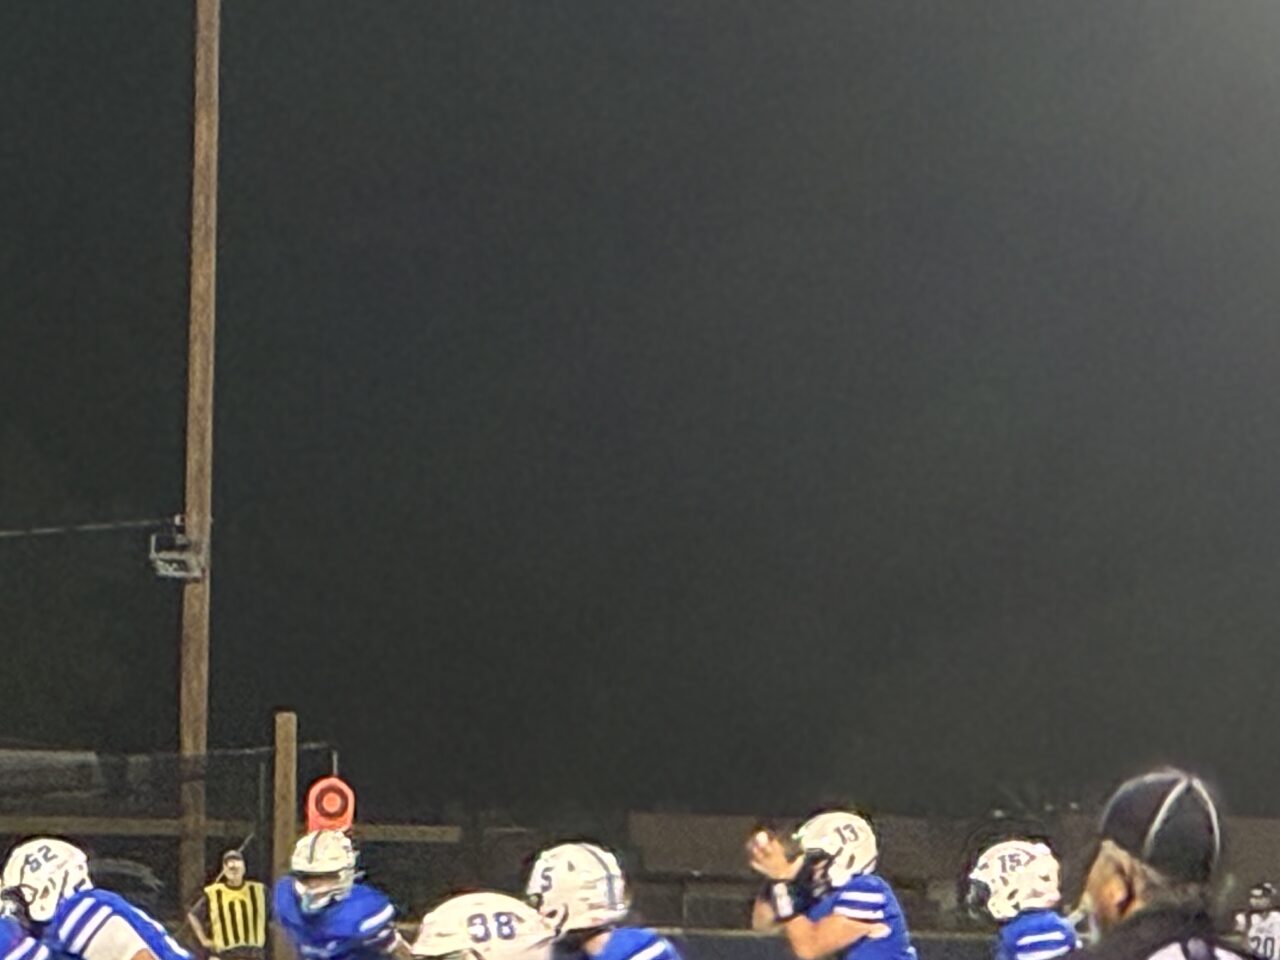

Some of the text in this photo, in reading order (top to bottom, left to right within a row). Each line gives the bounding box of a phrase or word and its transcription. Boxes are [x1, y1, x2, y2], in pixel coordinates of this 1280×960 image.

[834, 824, 860, 845] 13
[998, 853, 1022, 873] 15
[467, 911, 517, 942] 38
